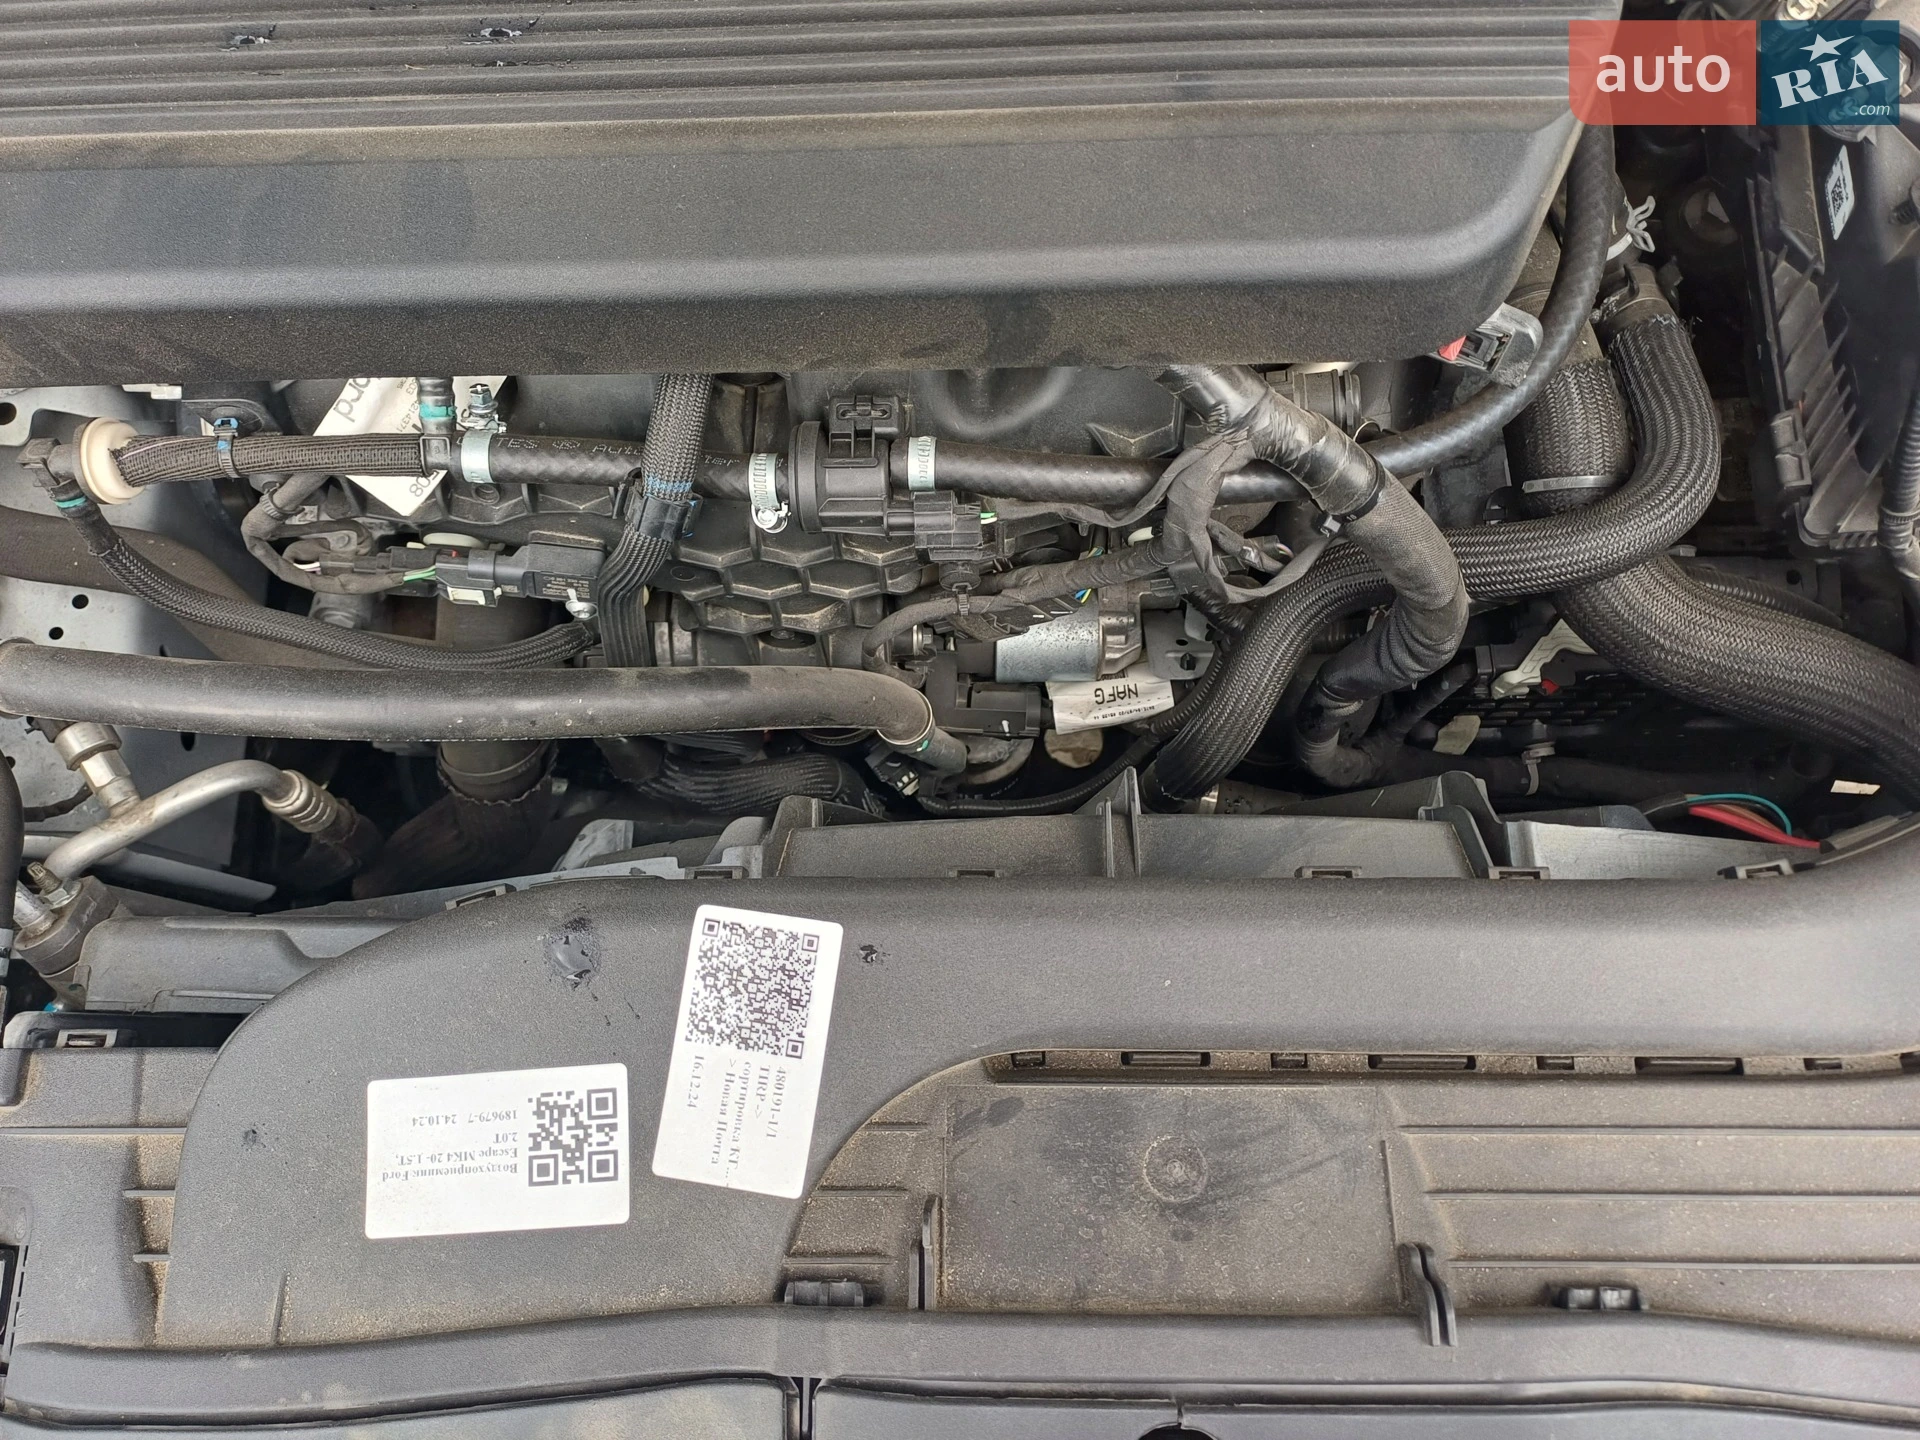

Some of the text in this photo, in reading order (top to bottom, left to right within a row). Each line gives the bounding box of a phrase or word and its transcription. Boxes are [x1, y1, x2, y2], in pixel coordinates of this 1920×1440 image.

[333, 378, 381, 423] ord
[1094, 683, 1139, 705] NAFG
[687, 1055, 704, 1108] 16.12.24
[719, 1072, 736, 1116] Новая
[756, 1065, 771, 1102] TIRP
[766, 1066, 787, 1138] 480191-1/1
[412, 1110, 517, 1127] 189679-7 24.10.24
[493, 1132, 518, 1143] 2.0T
[479, 1147, 518, 1158] Escape
[382, 1170, 409, 1182] Ford
